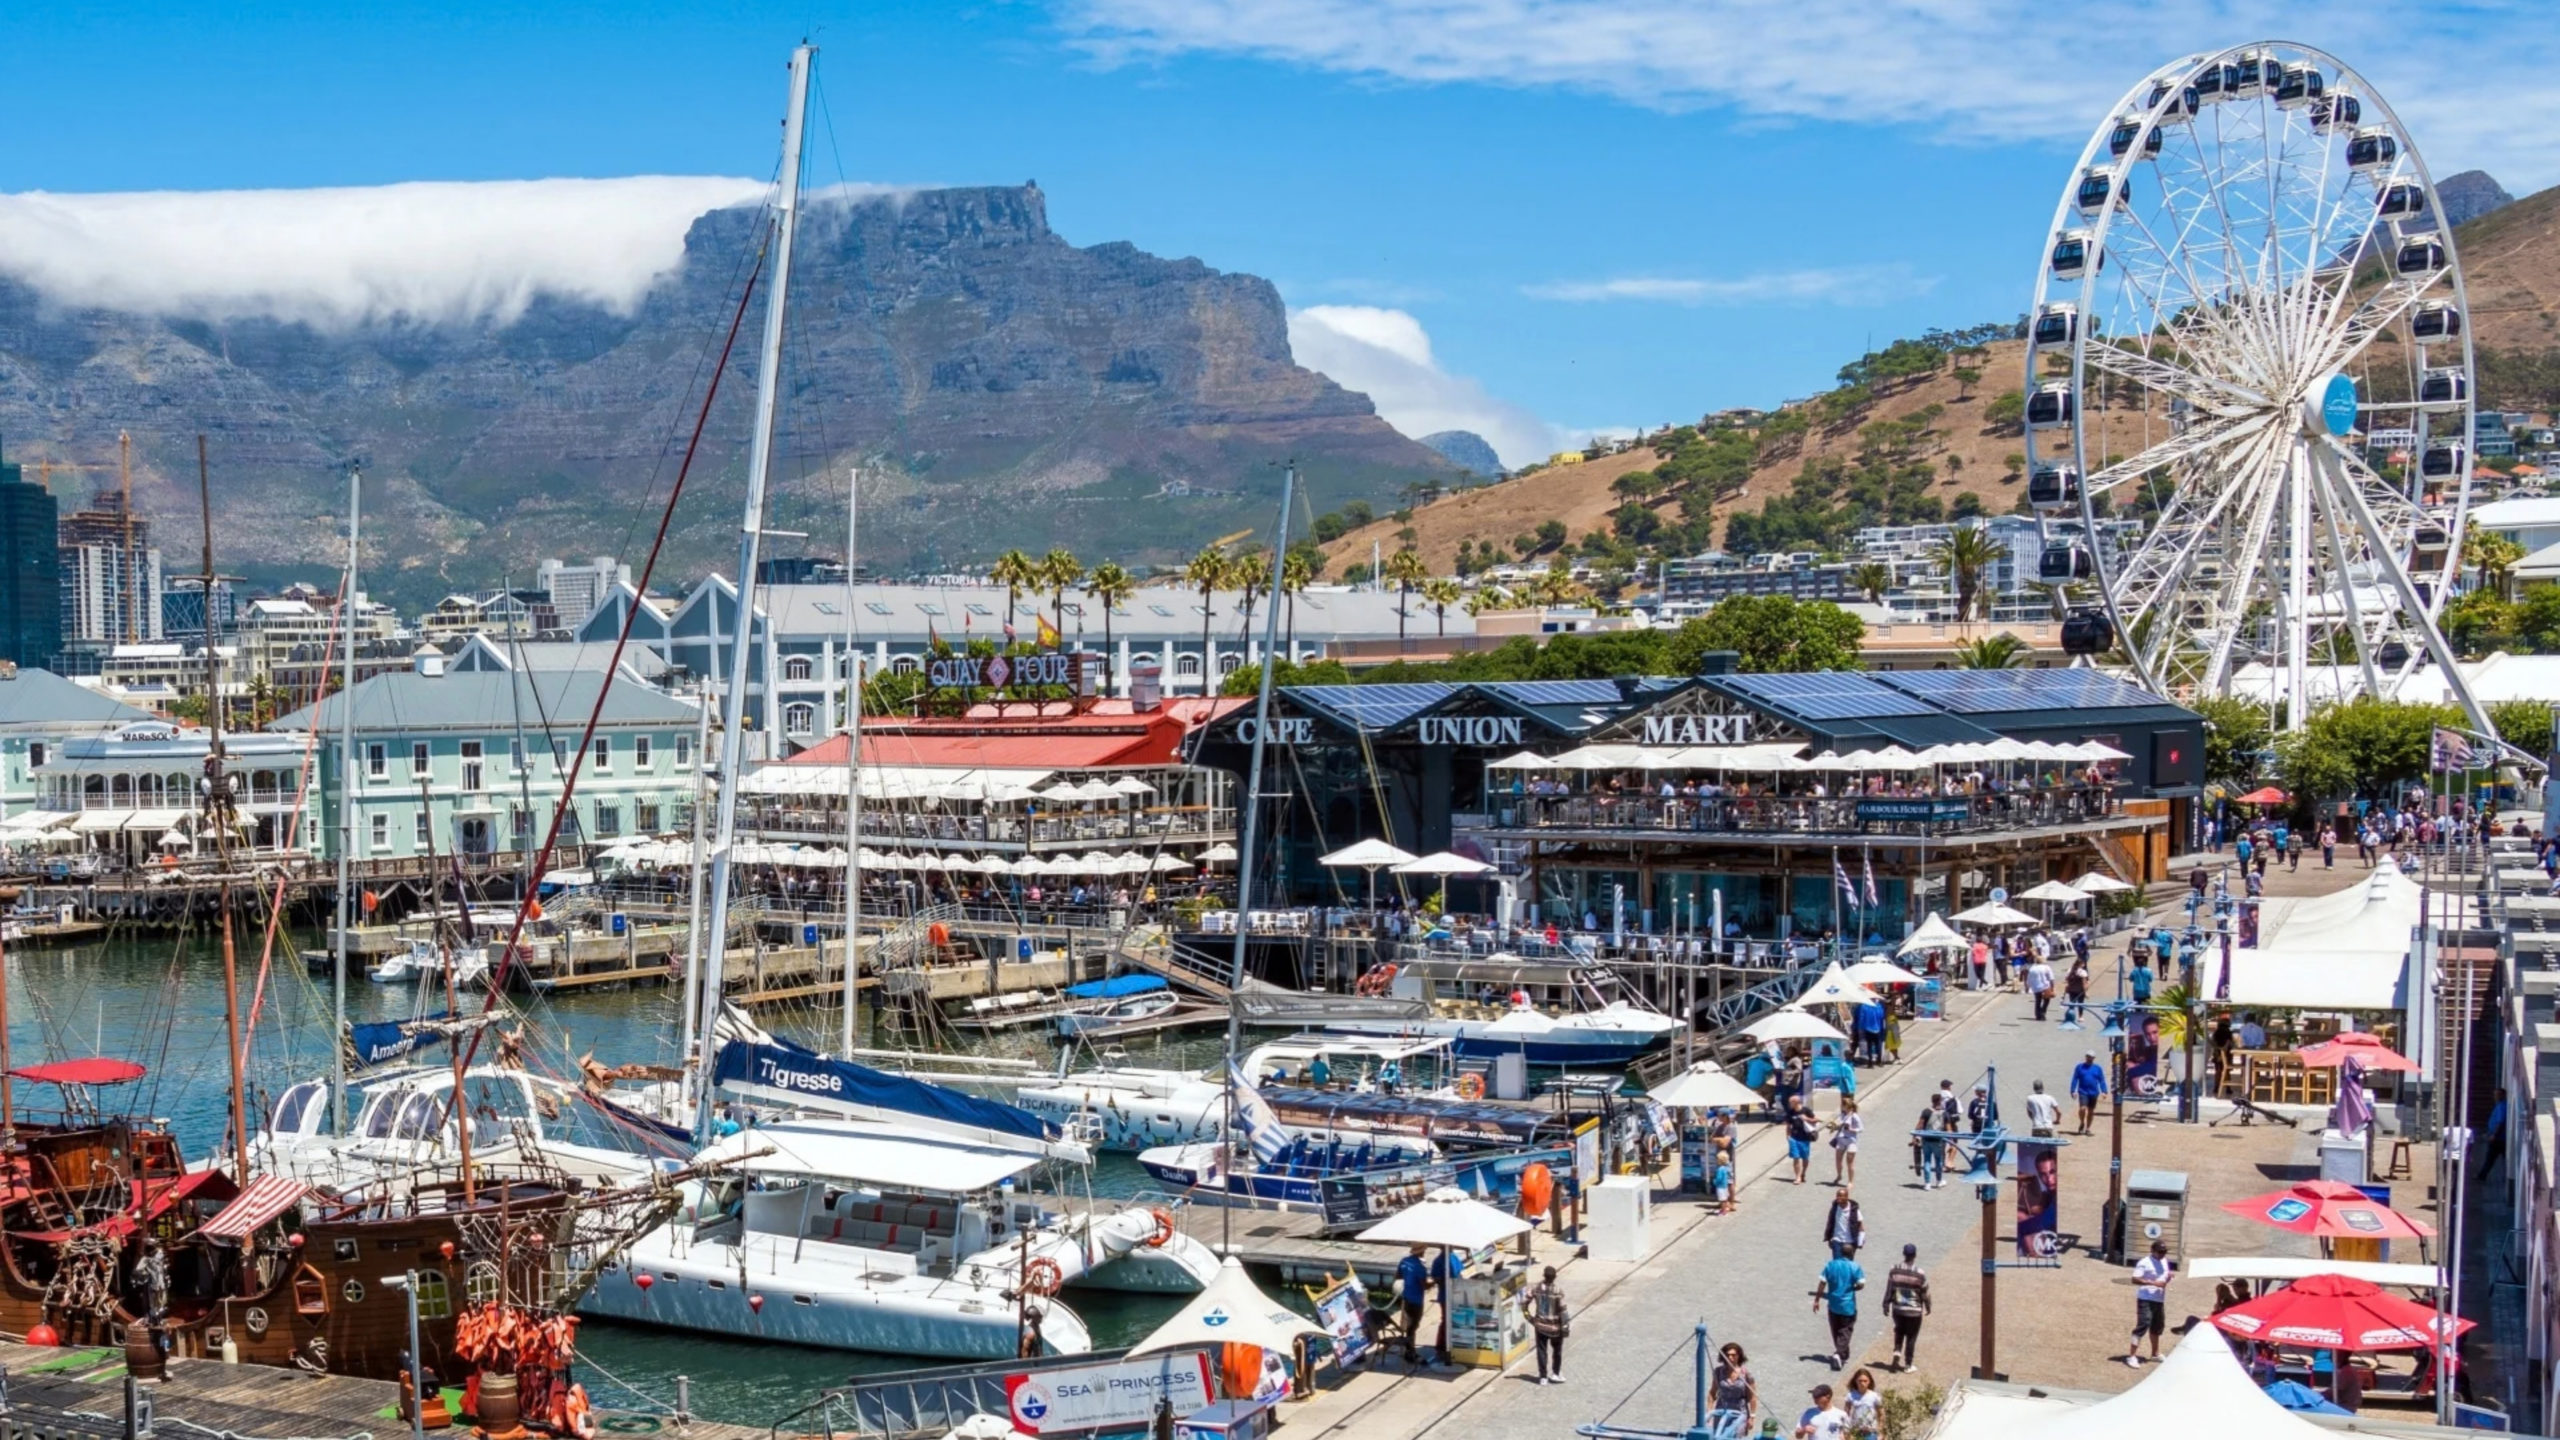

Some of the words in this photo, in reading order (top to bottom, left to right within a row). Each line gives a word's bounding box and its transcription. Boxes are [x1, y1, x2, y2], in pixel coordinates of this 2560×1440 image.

[931, 658, 984, 687] QUAY
[1014, 655, 1069, 684] FOUR
[1237, 717, 1313, 744] CAPE
[1418, 716, 1522, 744] UNION
[1642, 715, 1752, 744] MART
[1858, 804, 1899, 814] HARBOUR
[1900, 804, 1929, 814] HOUSE
[761, 1058, 842, 1092] Tigresse
[1020, 1098, 1058, 1113] ESCAPE
[1057, 1384, 1091, 1398] SEA
[1109, 1372, 1196, 1390] PRINCESS
